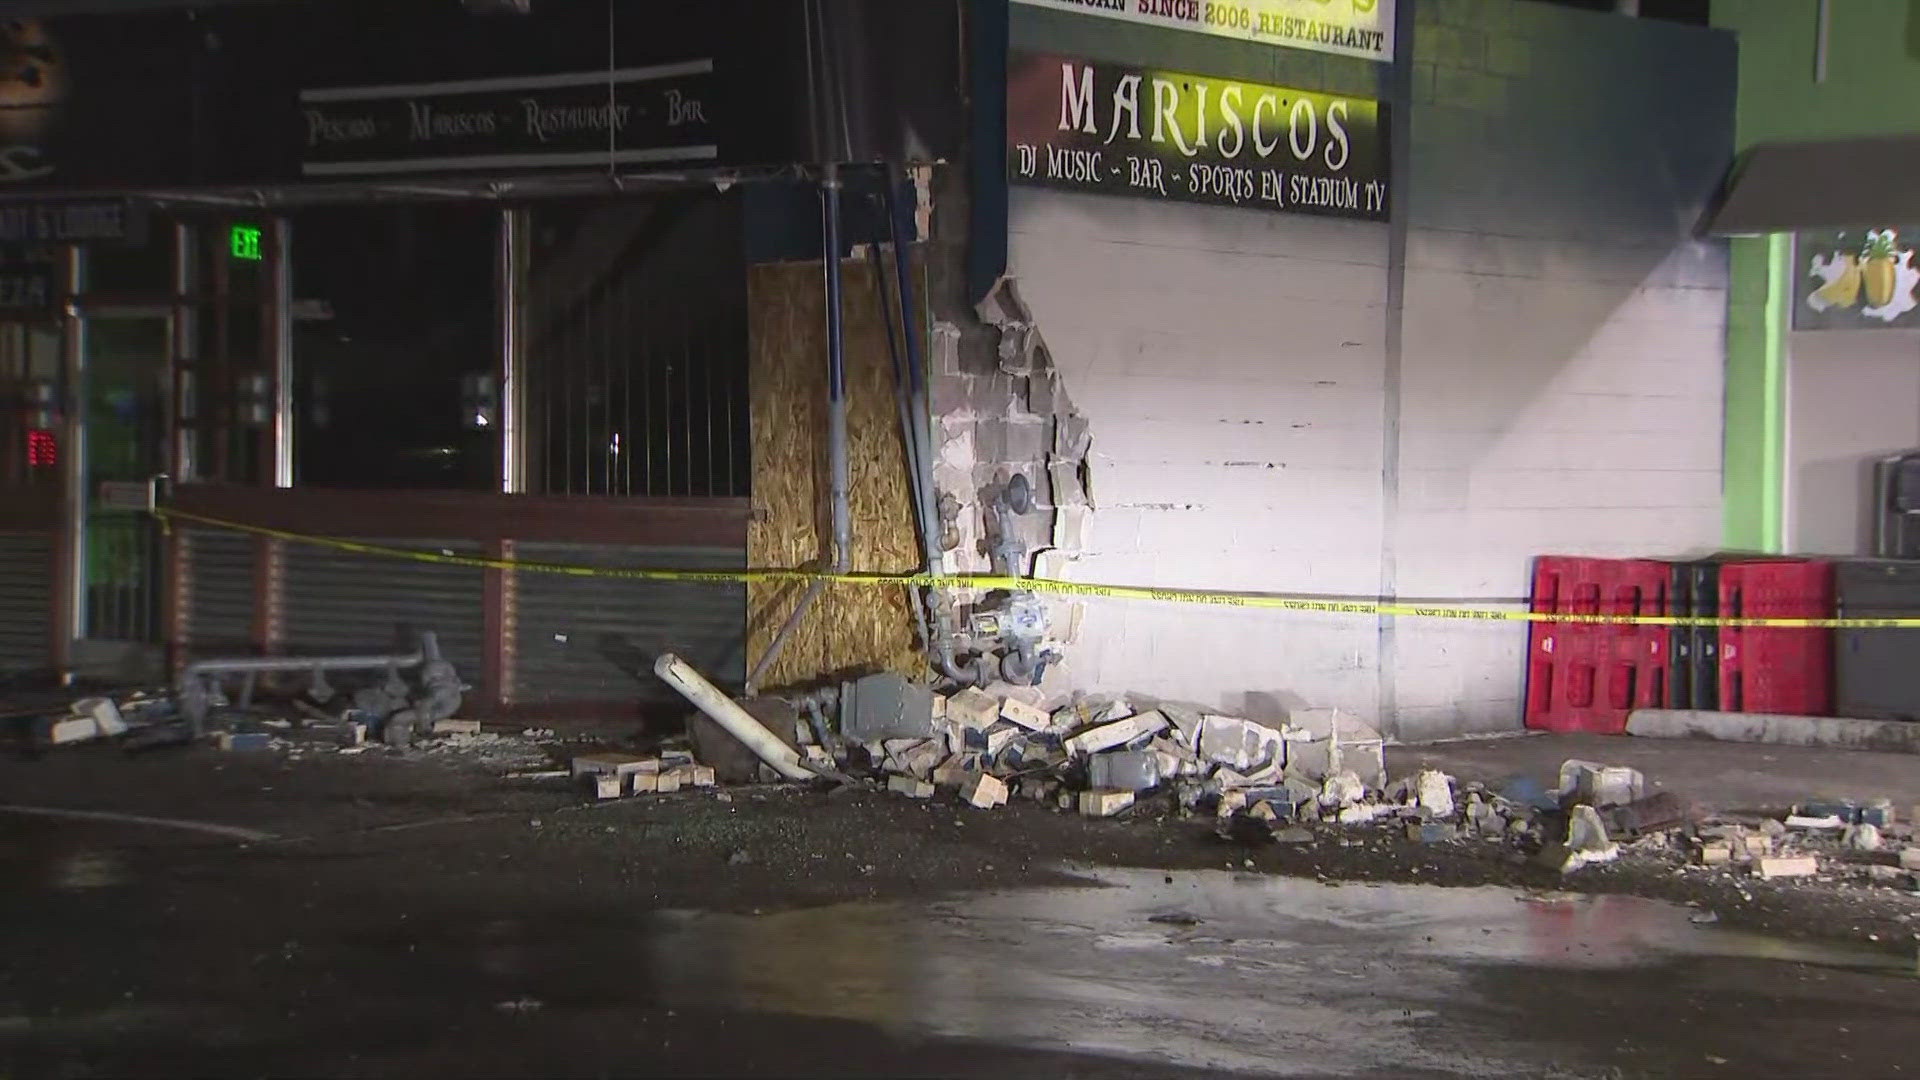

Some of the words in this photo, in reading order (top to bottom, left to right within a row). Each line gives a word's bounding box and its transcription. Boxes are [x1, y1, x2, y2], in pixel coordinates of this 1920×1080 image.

[1138, 0, 1198, 22] SINCE
[1205, 3, 1250, 30] 2006
[1258, 13, 1384, 51] RESTAURANT
[1058, 63, 1349, 171] MARISCOS
[1016, 144, 1037, 178] DJ
[1047, 143, 1102, 183] MUSIC
[1127, 156, 1167, 196] BAR
[1189, 163, 1254, 204] SPORTS
[1261, 169, 1284, 208] EN
[1290, 174, 1358, 210] STADIUM
[1365, 179, 1385, 212] TV
